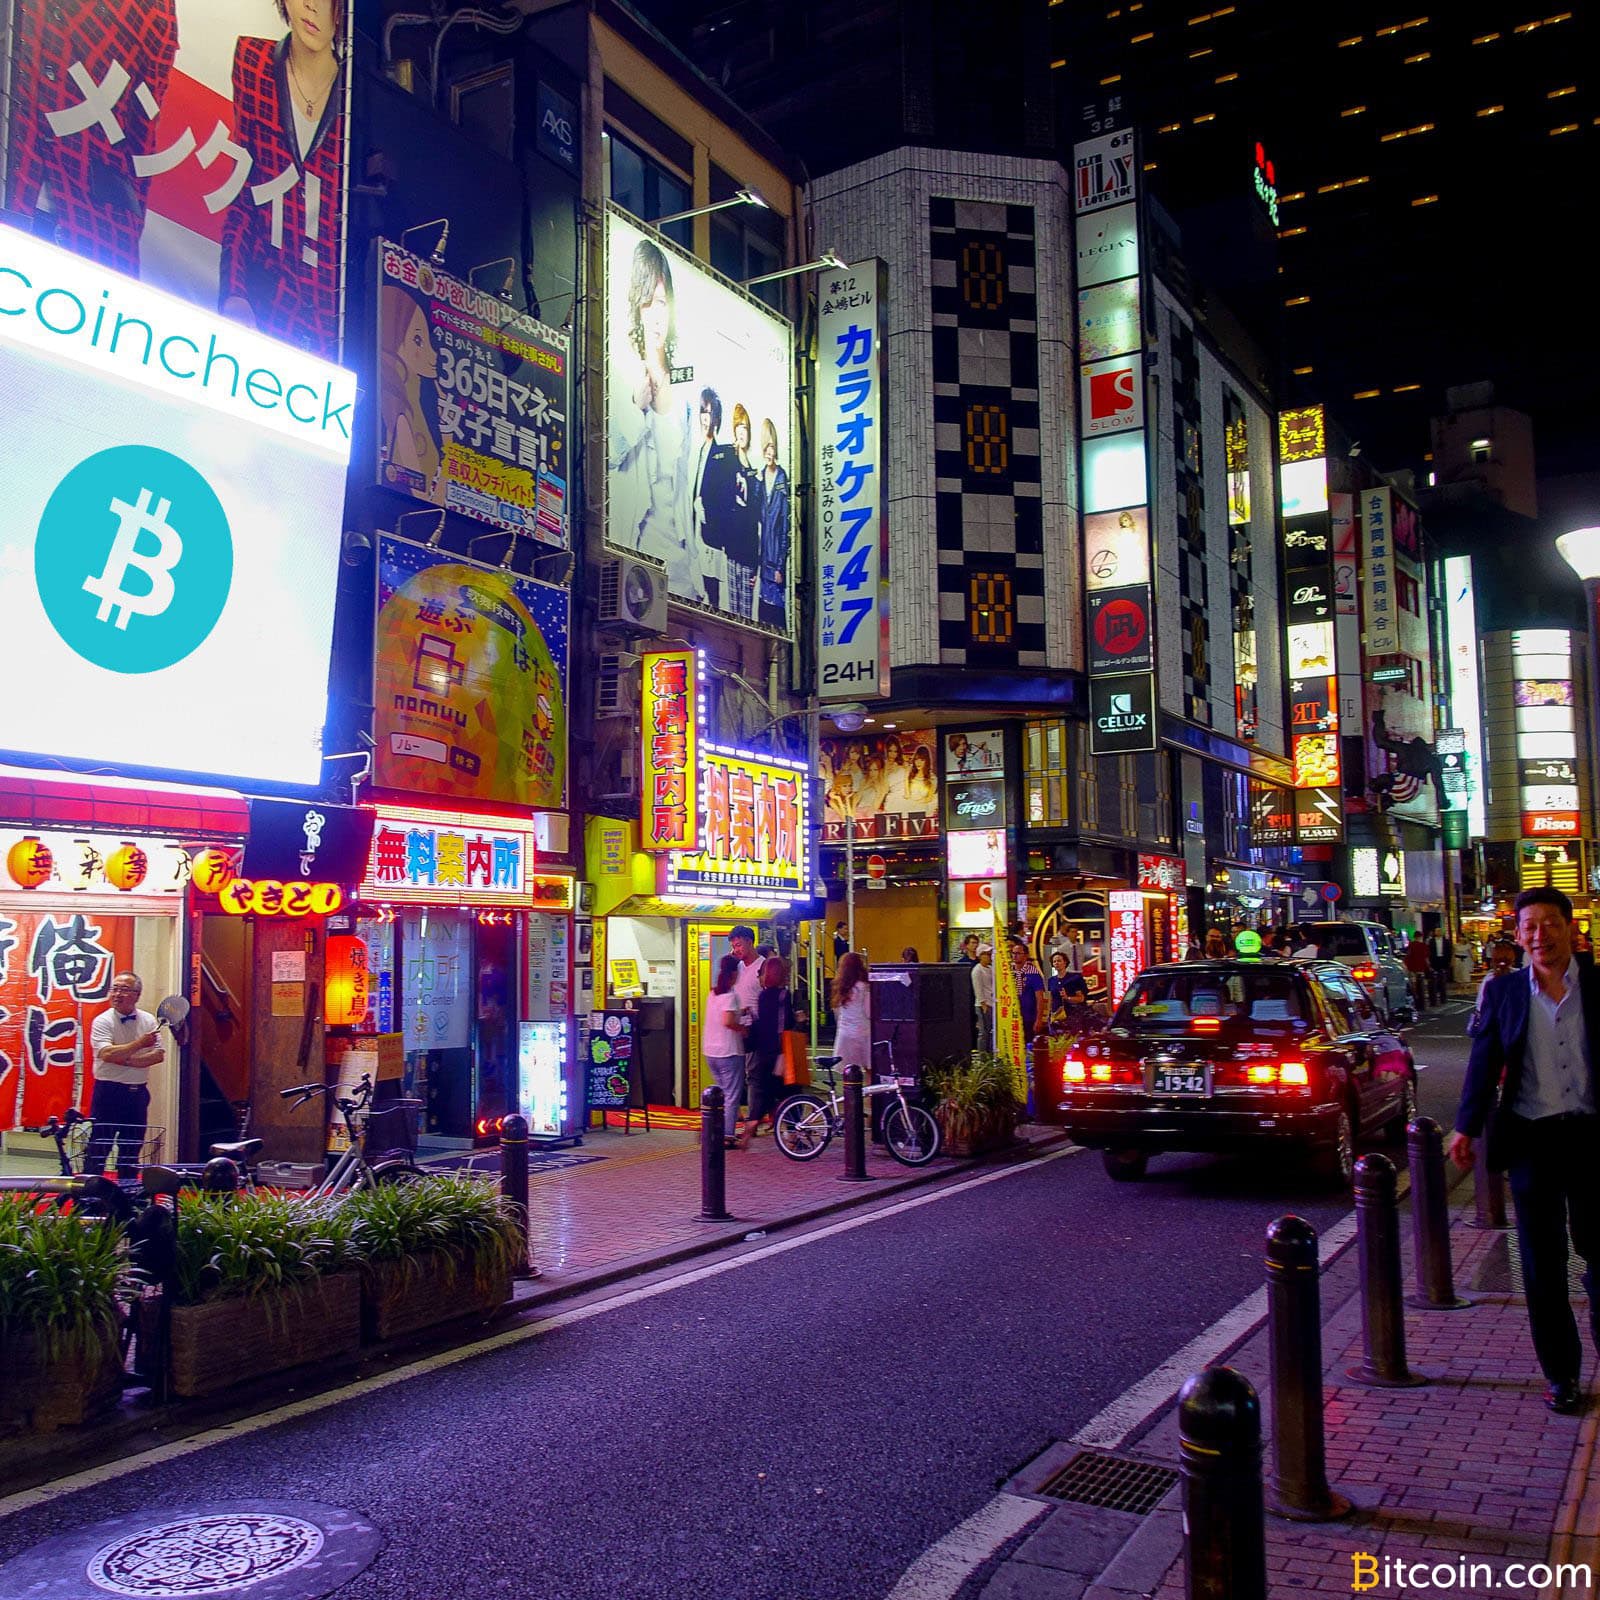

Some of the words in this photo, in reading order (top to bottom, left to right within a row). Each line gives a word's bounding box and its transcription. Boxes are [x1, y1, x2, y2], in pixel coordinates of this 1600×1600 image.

[542, 109, 572, 145] AXIS
[1091, 117, 1114, 132] 32
[1111, 133, 1132, 148] 6F
[1086, 192, 1111, 206] LOVE
[385, 251, 418, 288] お金
[0, 267, 351, 438] coincheck
[439, 348, 565, 427] 365日マネー
[439, 394, 548, 474] 女子宣言!
[1090, 414, 1135, 431] SLOW
[835, 325, 873, 645] カラオケ747
[1369, 495, 1389, 630] 台湾同郷協同組合
[416, 598, 473, 633] 遊ぶ
[822, 564, 835, 647] 東宝ビル前
[1373, 635, 1392, 648] ビル
[824, 661, 874, 684] 24H
[1097, 713, 1147, 729] CELUX
[651, 659, 688, 842] 無料案内所
[700, 761, 798, 866] 料案内所
[818, 822, 866, 841] RTY
[375, 825, 522, 889] 無料案内所
[347, 947, 366, 1018] 焼き鳥
